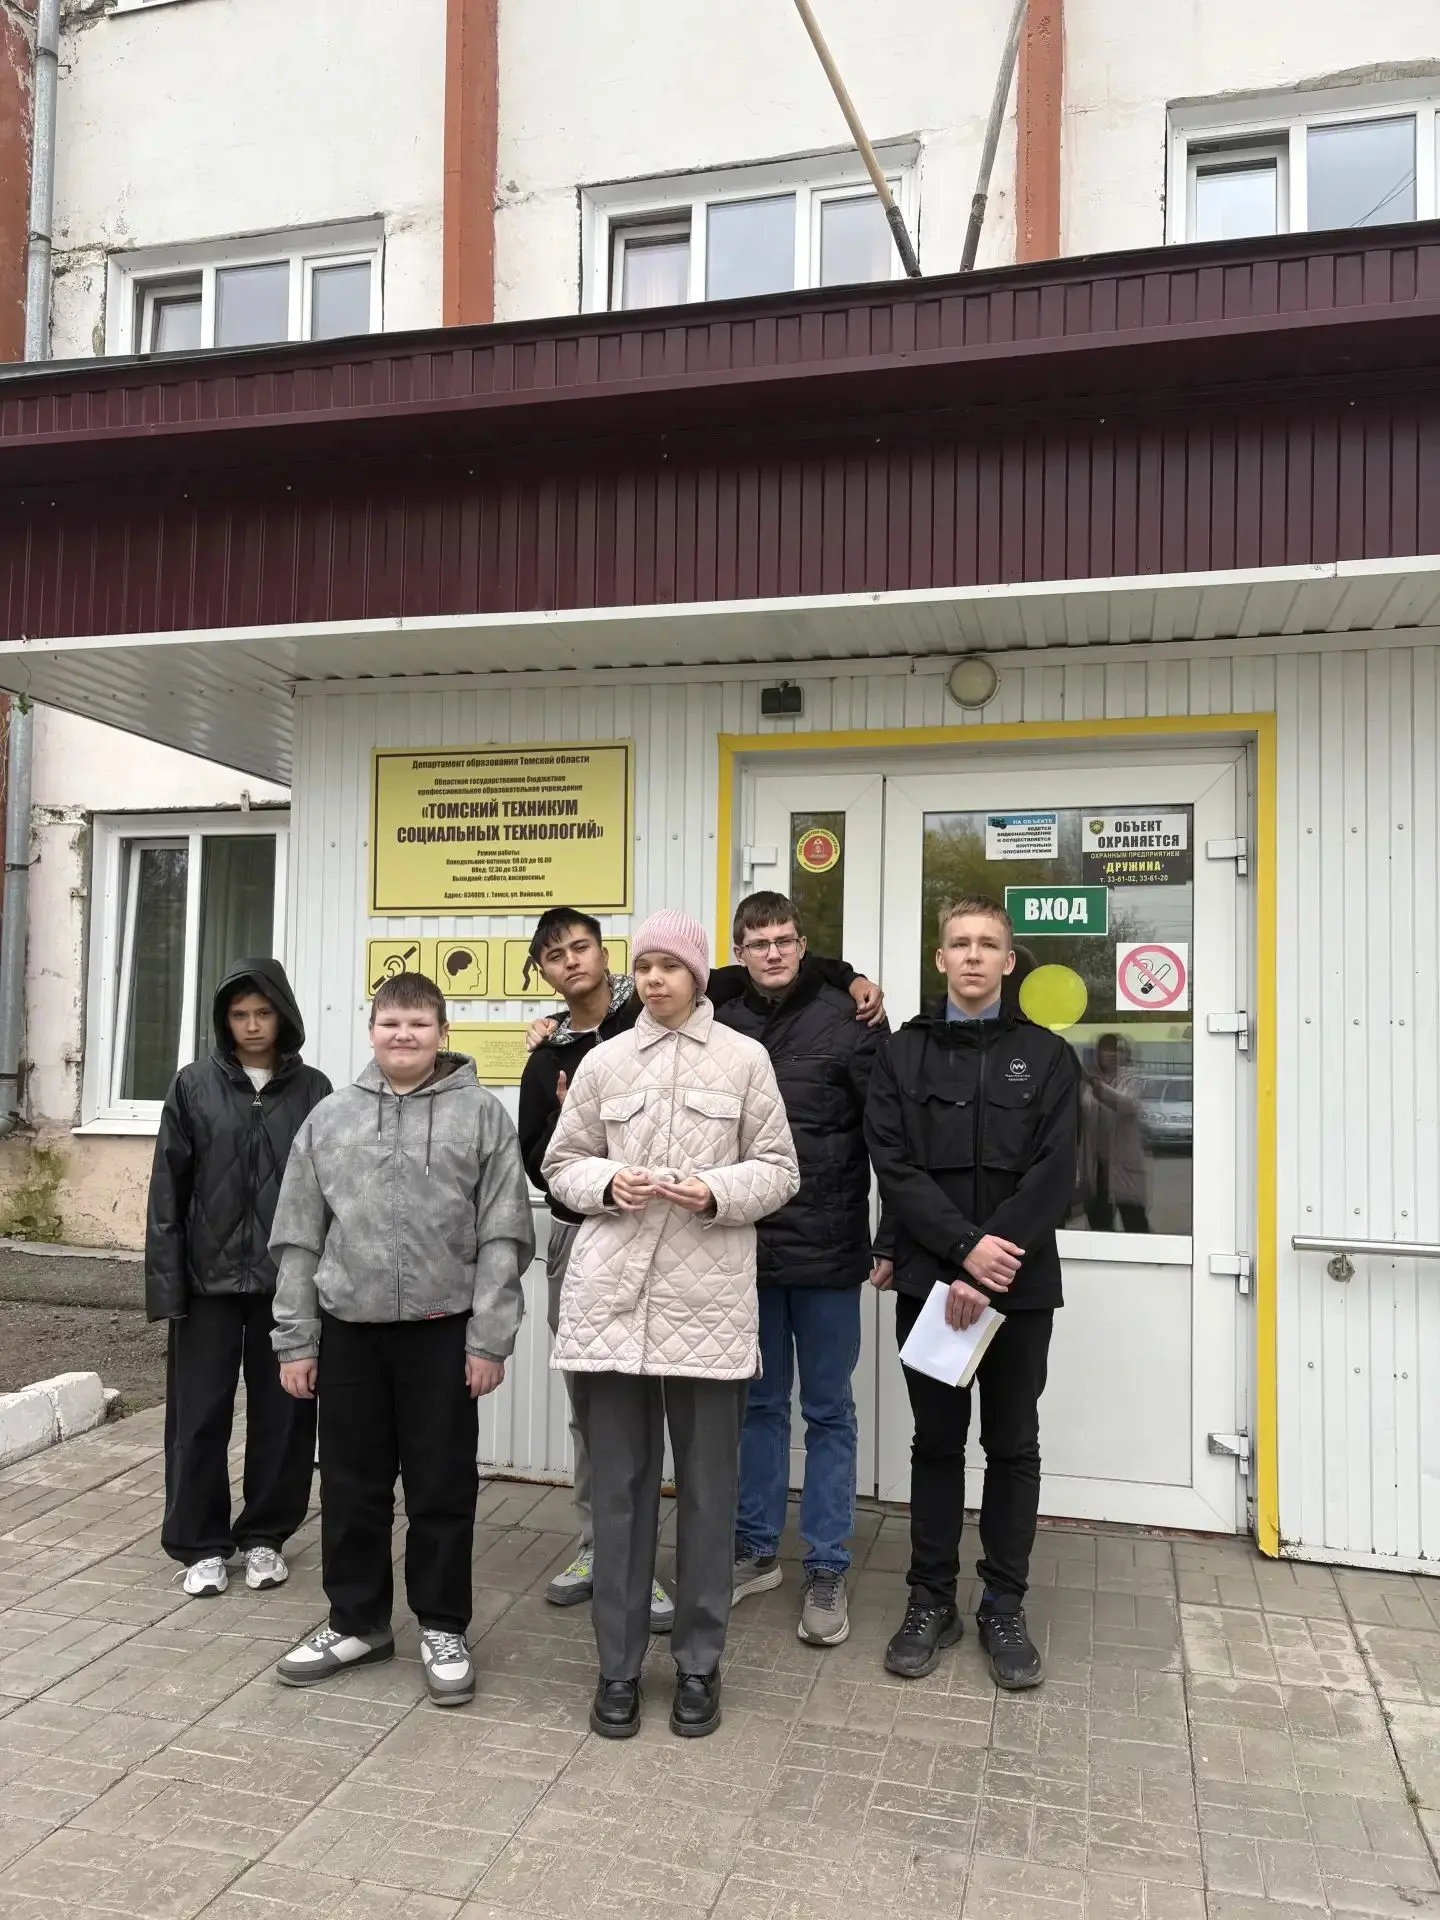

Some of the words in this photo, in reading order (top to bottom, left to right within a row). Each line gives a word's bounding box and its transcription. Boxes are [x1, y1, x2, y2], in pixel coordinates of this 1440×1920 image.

[412, 760, 465, 770] Департамент
[467, 758, 518, 768] образования
[520, 756, 554, 766] Томской
[556, 755, 590, 764] области
[434, 778, 468, 786] Областное
[470, 776, 525, 786] государственное
[527, 775, 566, 784] бюджетное
[418, 788, 482, 797] профессиональное
[483, 786, 540, 795] образовательное
[541, 784, 583, 793] учреждение
[421, 798, 499, 819] «ТОМСКИЙ
[502, 799, 578, 818] ТЕХНИКУМ
[397, 825, 500, 844] СОЦИАЛЬНЫХ
[503, 820, 604, 841] ТЕХНОЛОГИЙ»
[1114, 820, 1162, 833] ОБЪЕКТ
[1097, 834, 1180, 849] ОХРАНЯЕТСЯ
[508, 874, 545, 882] воскресенье
[1024, 897, 1088, 924] ВХОД
